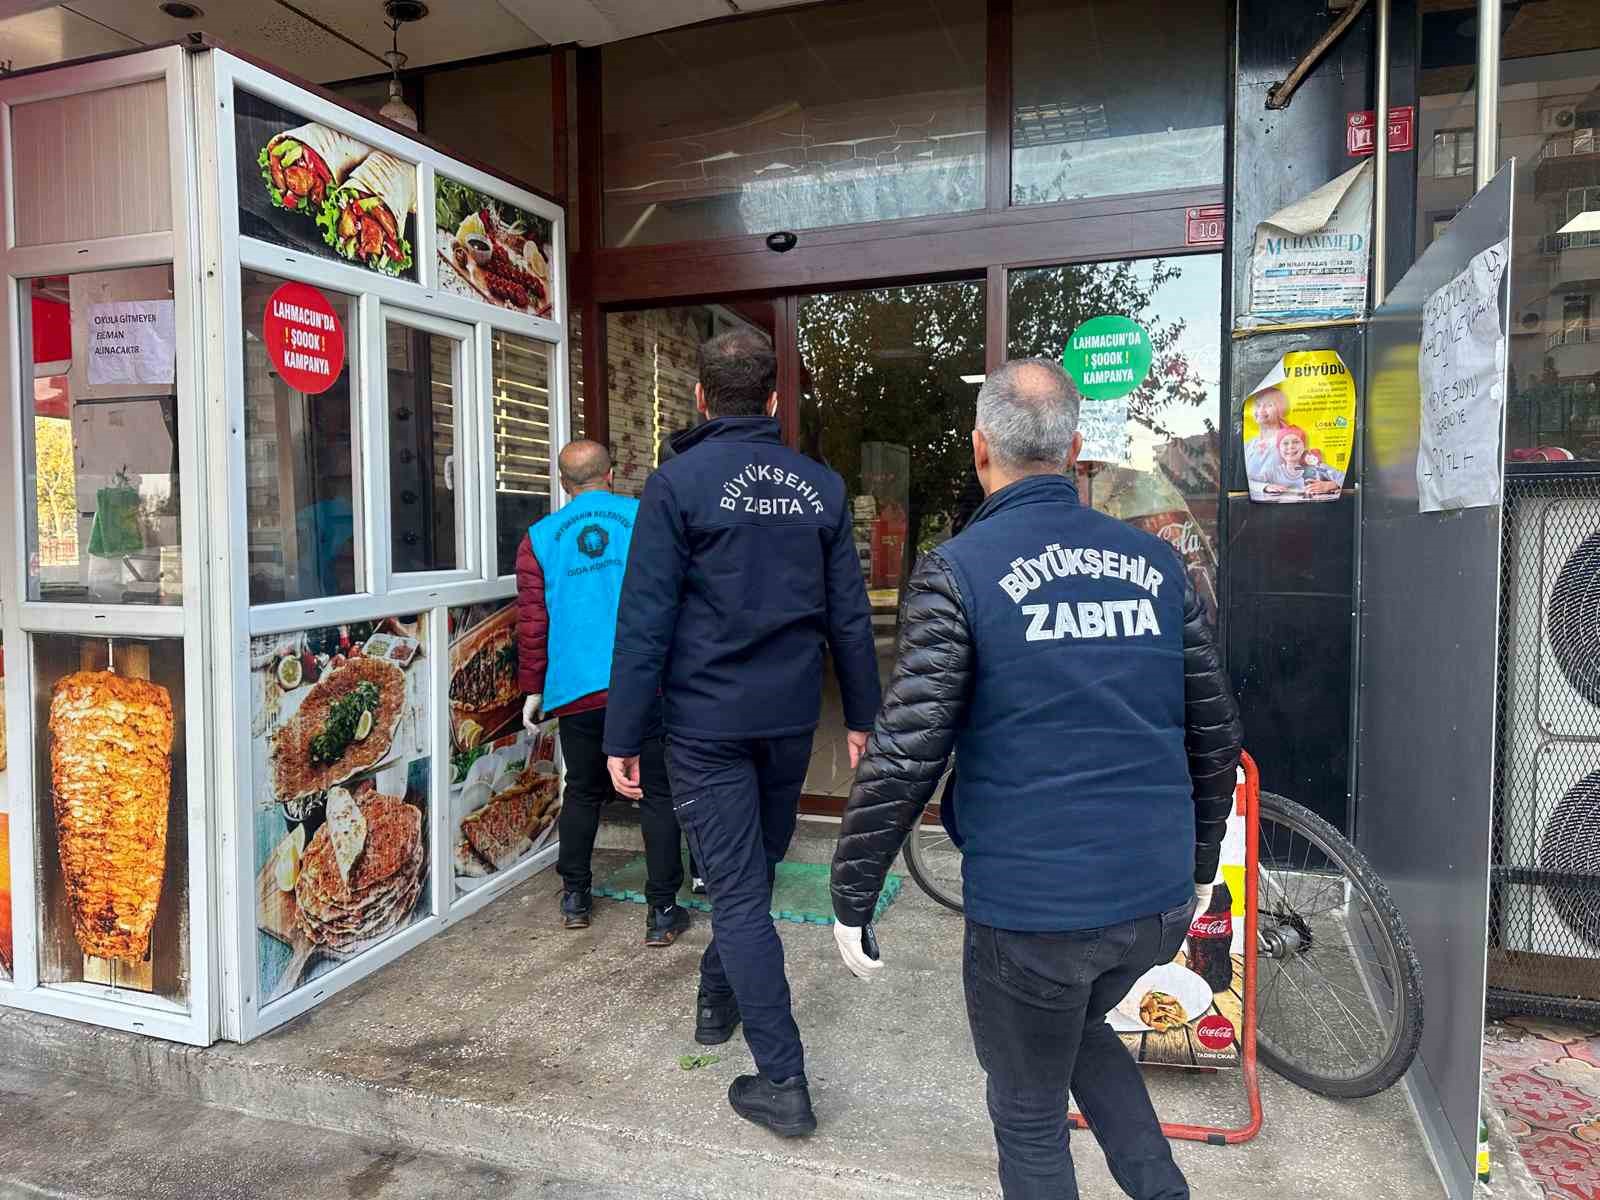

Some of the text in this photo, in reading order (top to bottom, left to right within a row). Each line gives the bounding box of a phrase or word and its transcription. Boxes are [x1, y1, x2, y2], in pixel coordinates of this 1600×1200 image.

[273, 300, 336, 332] LAHMACUN'DA
[291, 328, 320, 350] ŞOOOK
[1073, 332, 1141, 350] LAHMACUN'DA
[284, 350, 330, 375] KAMPANYA
[1091, 352, 1123, 369] ŞOOOK
[1083, 368, 1134, 385] KAMPANYA
[720, 463, 824, 515] BÜYÜKŞEHİR
[998, 543, 1164, 604] BÜYÜKŞEHİR
[1021, 598, 1162, 642] ZABITA
